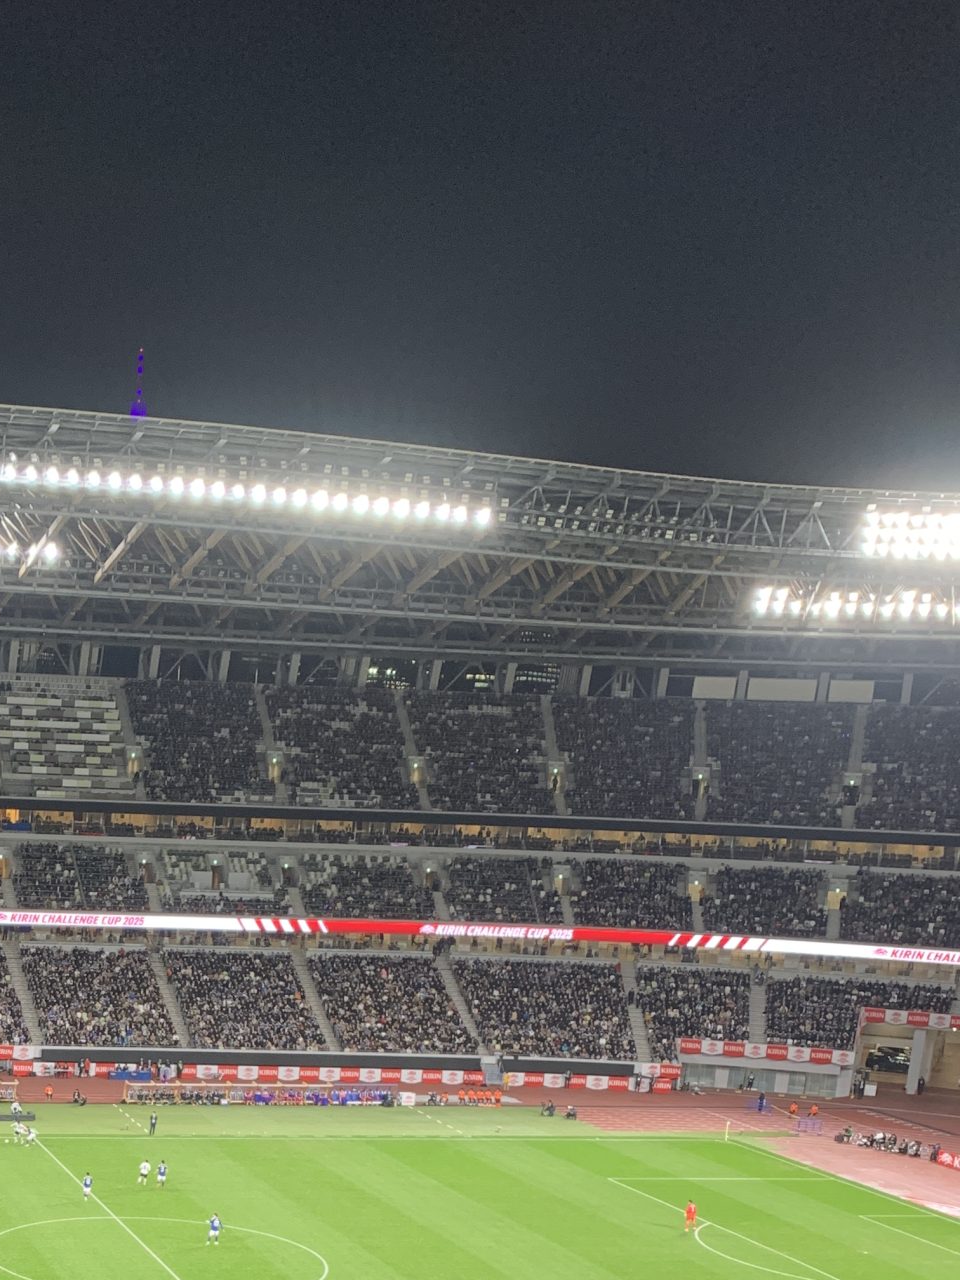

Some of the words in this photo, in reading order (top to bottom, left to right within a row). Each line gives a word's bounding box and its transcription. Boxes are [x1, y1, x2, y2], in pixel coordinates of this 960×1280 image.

[10, 913, 39, 923] KIRIN
[42, 914, 99, 924] CHALLENGE
[101, 915, 122, 925] CUP
[124, 916, 145, 926] 2025
[435, 924, 466, 935] KIRIN
[467, 925, 525, 938] CHALLENGE
[527, 928, 549, 939] CUP
[549, 929, 574, 940] 2025
[890, 948, 925, 960] KIRIN
